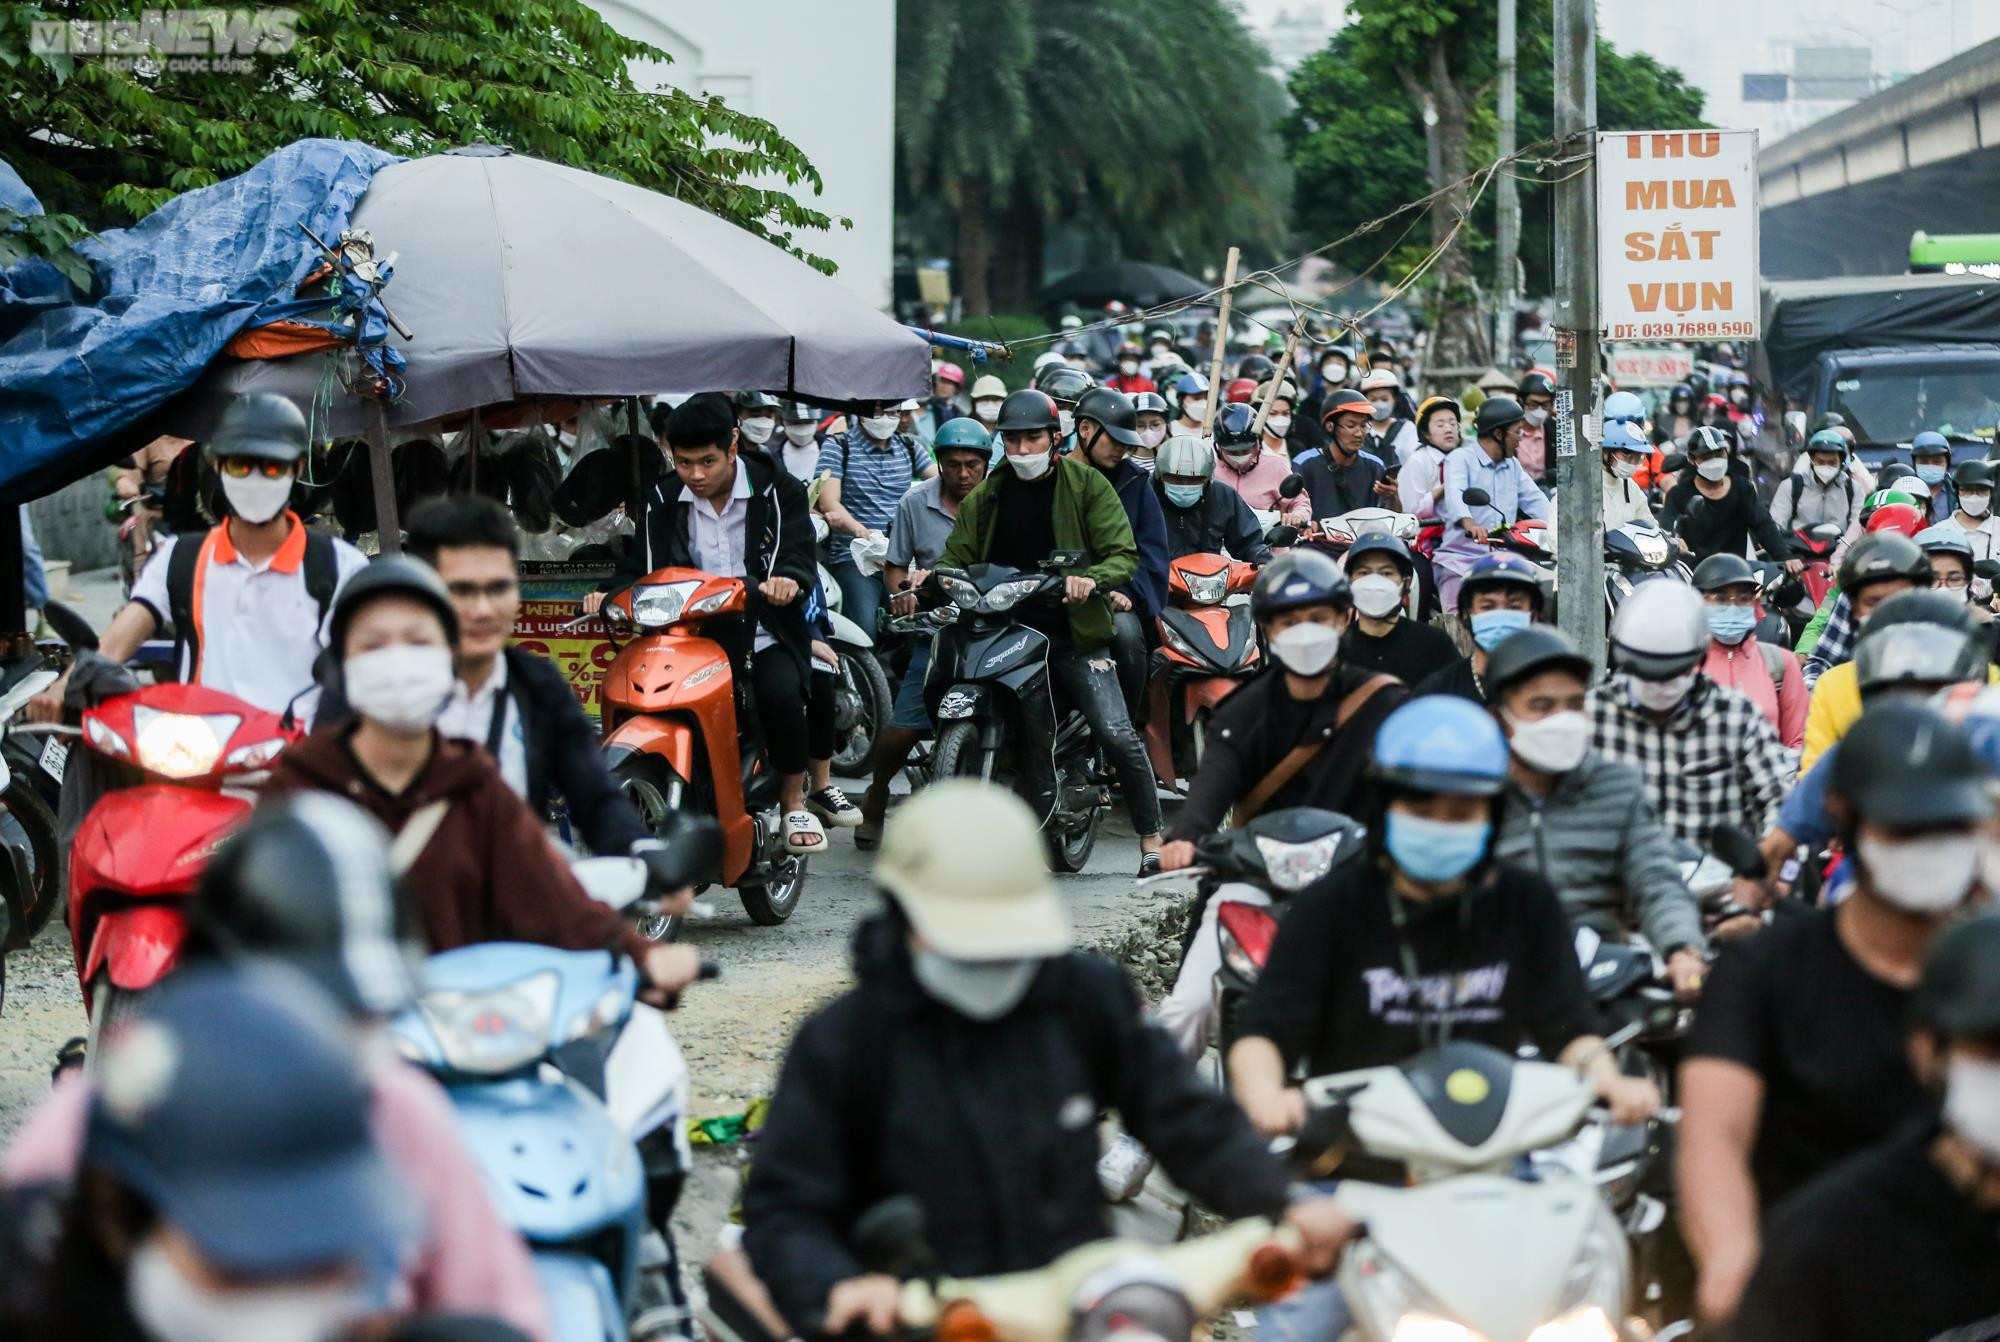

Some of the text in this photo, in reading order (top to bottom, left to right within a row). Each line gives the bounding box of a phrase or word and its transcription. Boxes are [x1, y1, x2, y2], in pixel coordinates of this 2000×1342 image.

[1625, 179, 1736, 210] MUA
[1624, 222, 1721, 261] SẮT
[1627, 281, 1733, 317] VỤN
[1642, 322, 1753, 337] 039.7689.590
[527, 604, 575, 616] THÊM
